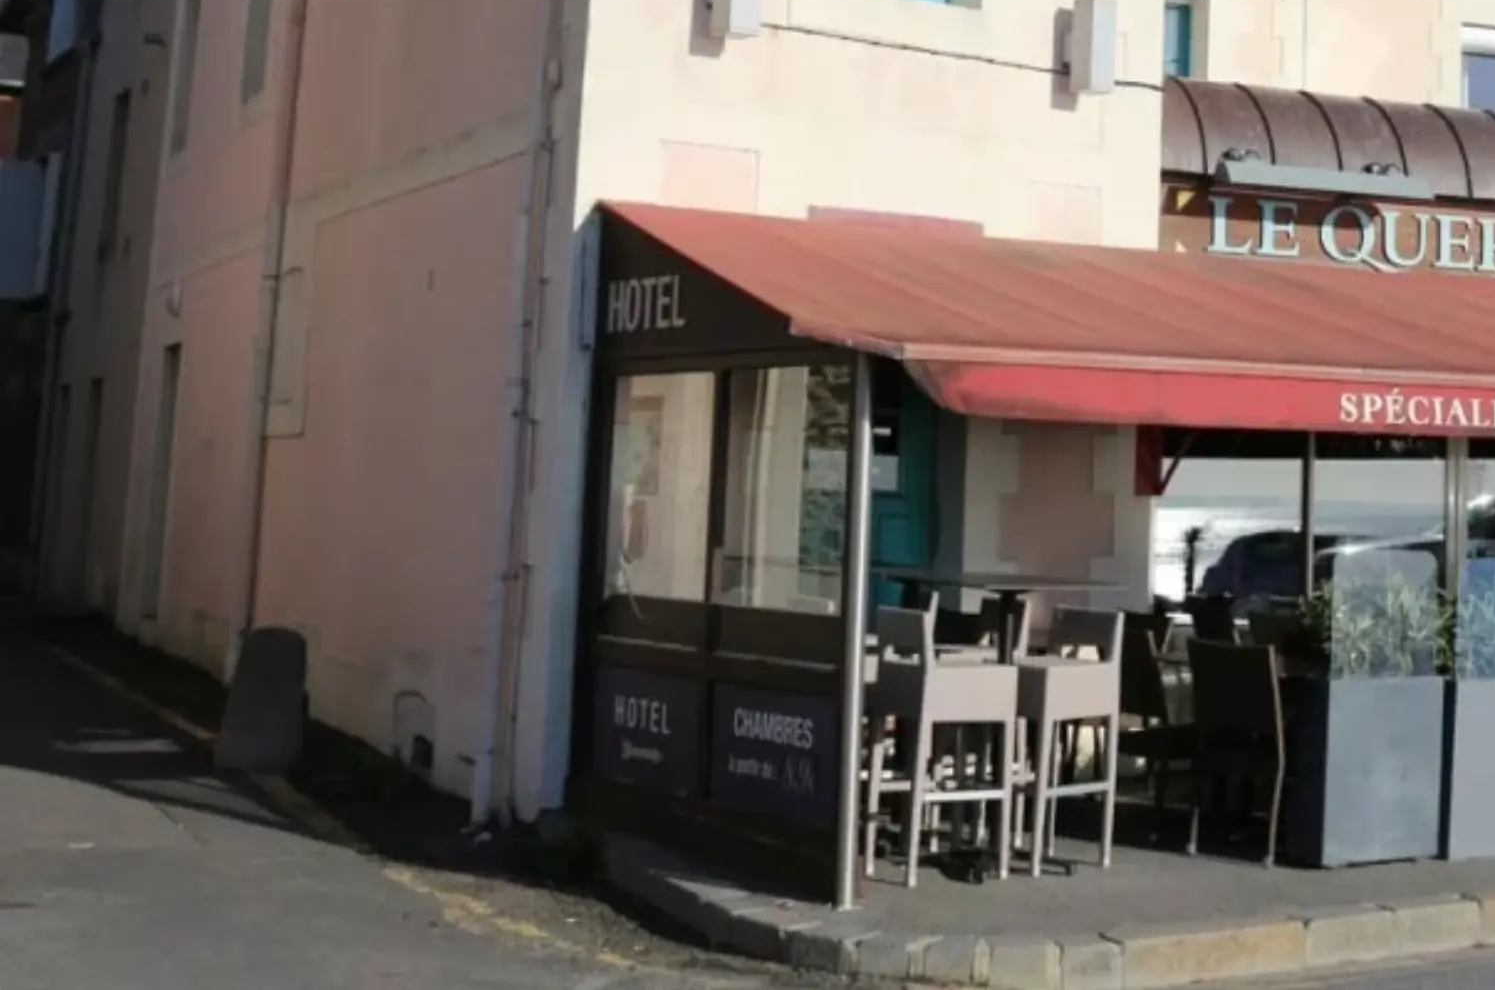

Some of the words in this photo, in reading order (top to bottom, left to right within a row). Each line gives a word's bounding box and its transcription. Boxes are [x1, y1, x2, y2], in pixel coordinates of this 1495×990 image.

[1208, 196, 1299, 257] LE
[607, 275, 685, 333] HOTEL
[614, 694, 671, 735] HOTEL
[733, 706, 814, 749] CHAMBRES
